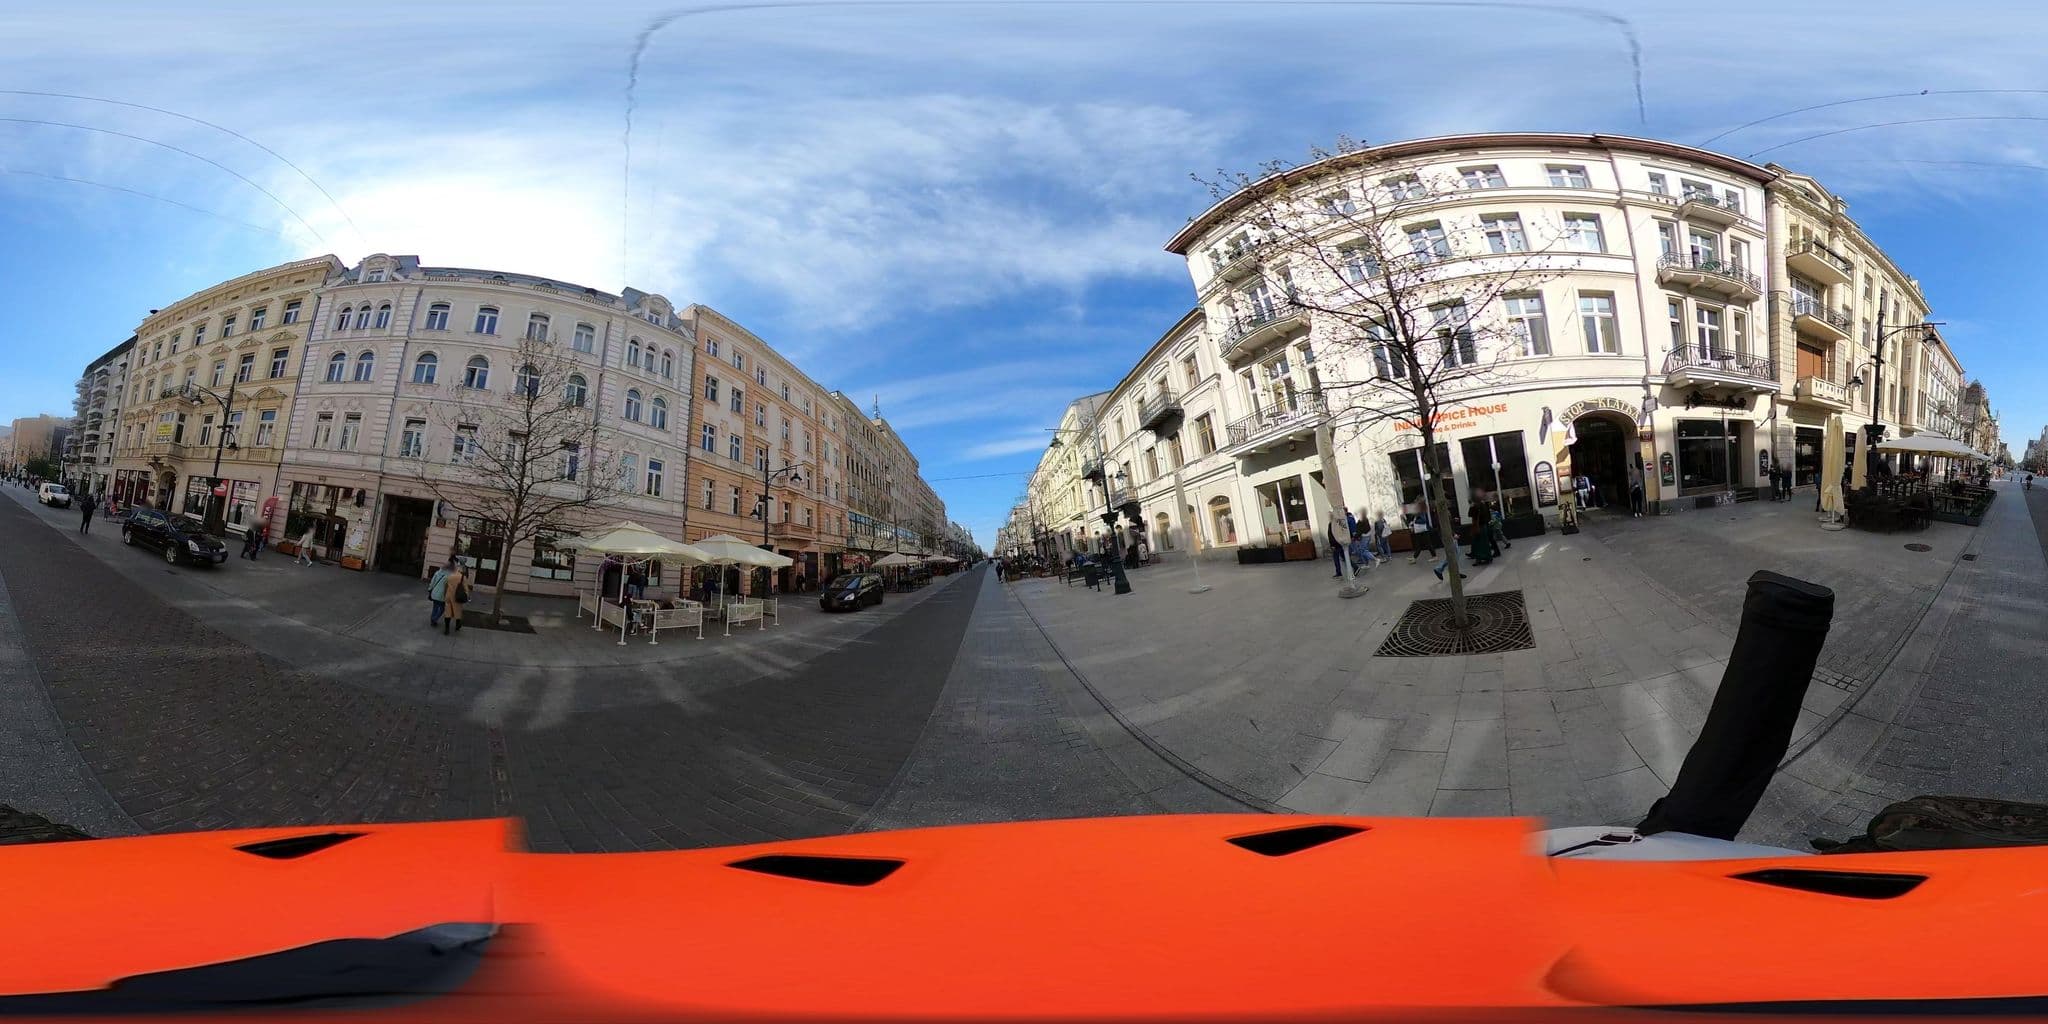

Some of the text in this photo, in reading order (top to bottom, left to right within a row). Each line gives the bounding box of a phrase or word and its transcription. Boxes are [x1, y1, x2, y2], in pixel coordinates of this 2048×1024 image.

[1468, 404, 1507, 417] HOUSE
[1560, 402, 1584, 424] STOP
[1451, 421, 1476, 430] Drinks
